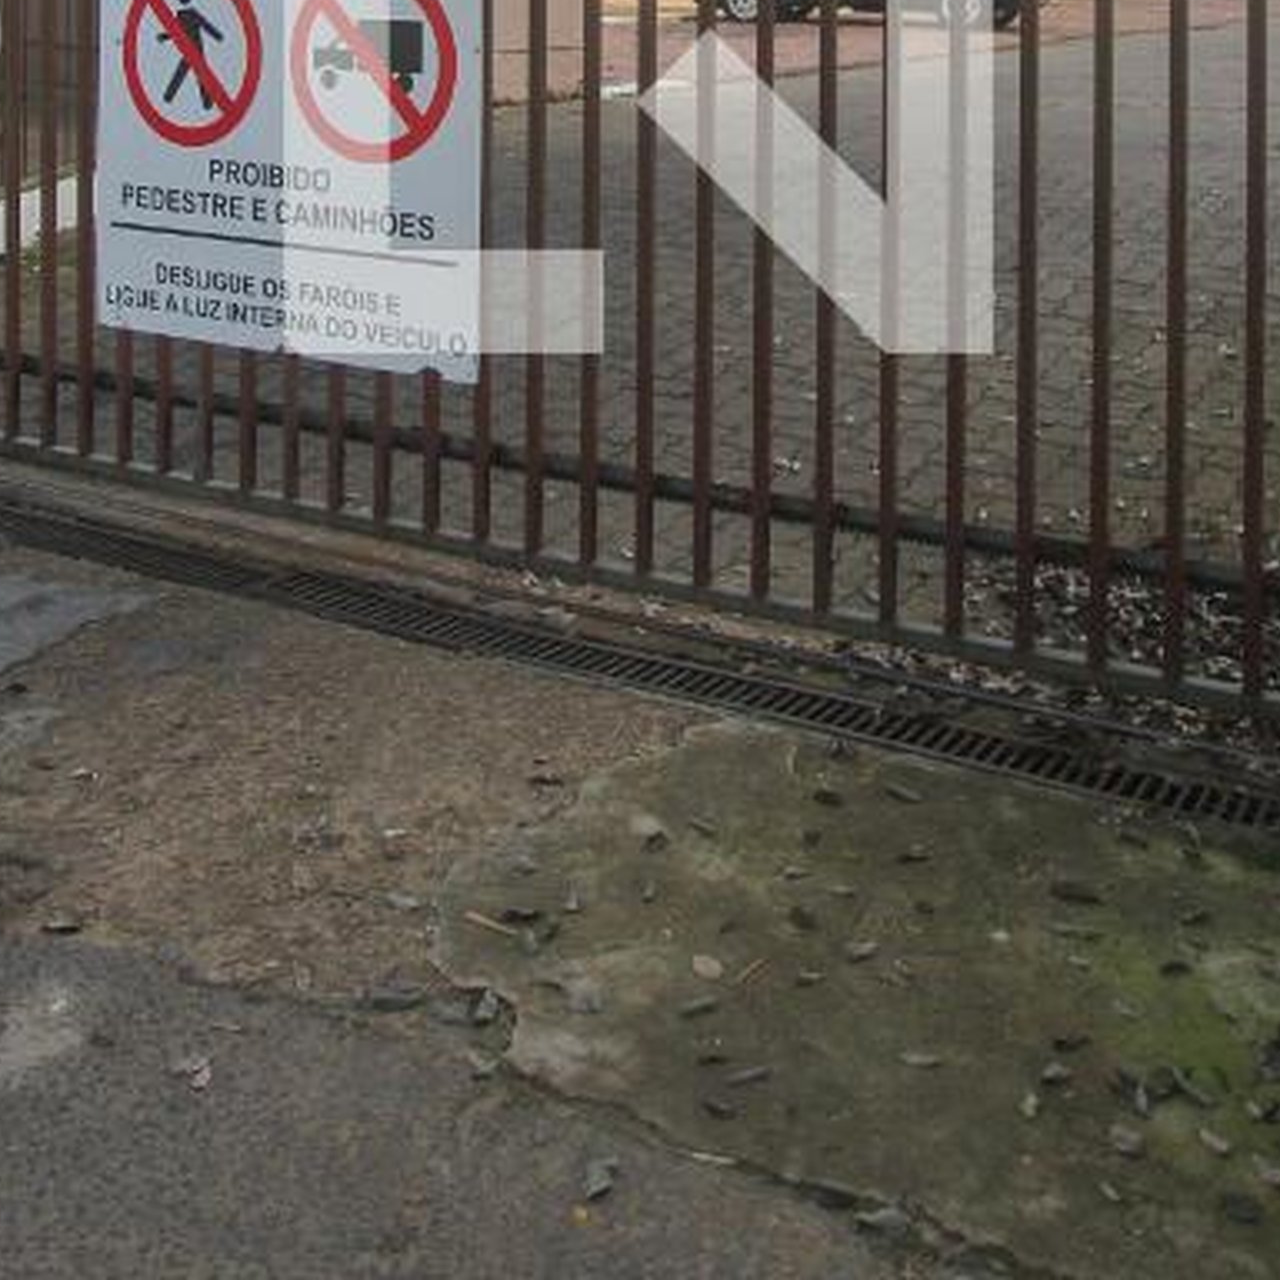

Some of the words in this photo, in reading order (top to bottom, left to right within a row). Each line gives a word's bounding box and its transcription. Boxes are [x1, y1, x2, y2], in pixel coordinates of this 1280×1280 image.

[209, 159, 331, 192] PROIBIDO
[121, 183, 245, 221] PEDESTRE
[253, 197, 268, 222] E
[275, 199, 435, 241] CAMINHÕES
[106, 284, 161, 312] LIGUE
[166, 293, 179, 313] A
[183, 296, 222, 321] LUZ
[227, 302, 318, 334] INTERNA
[326, 316, 358, 341] DO
[156, 261, 256, 297] DESLIGUE
[262, 277, 290, 300] OS
[386, 293, 401, 318] E
